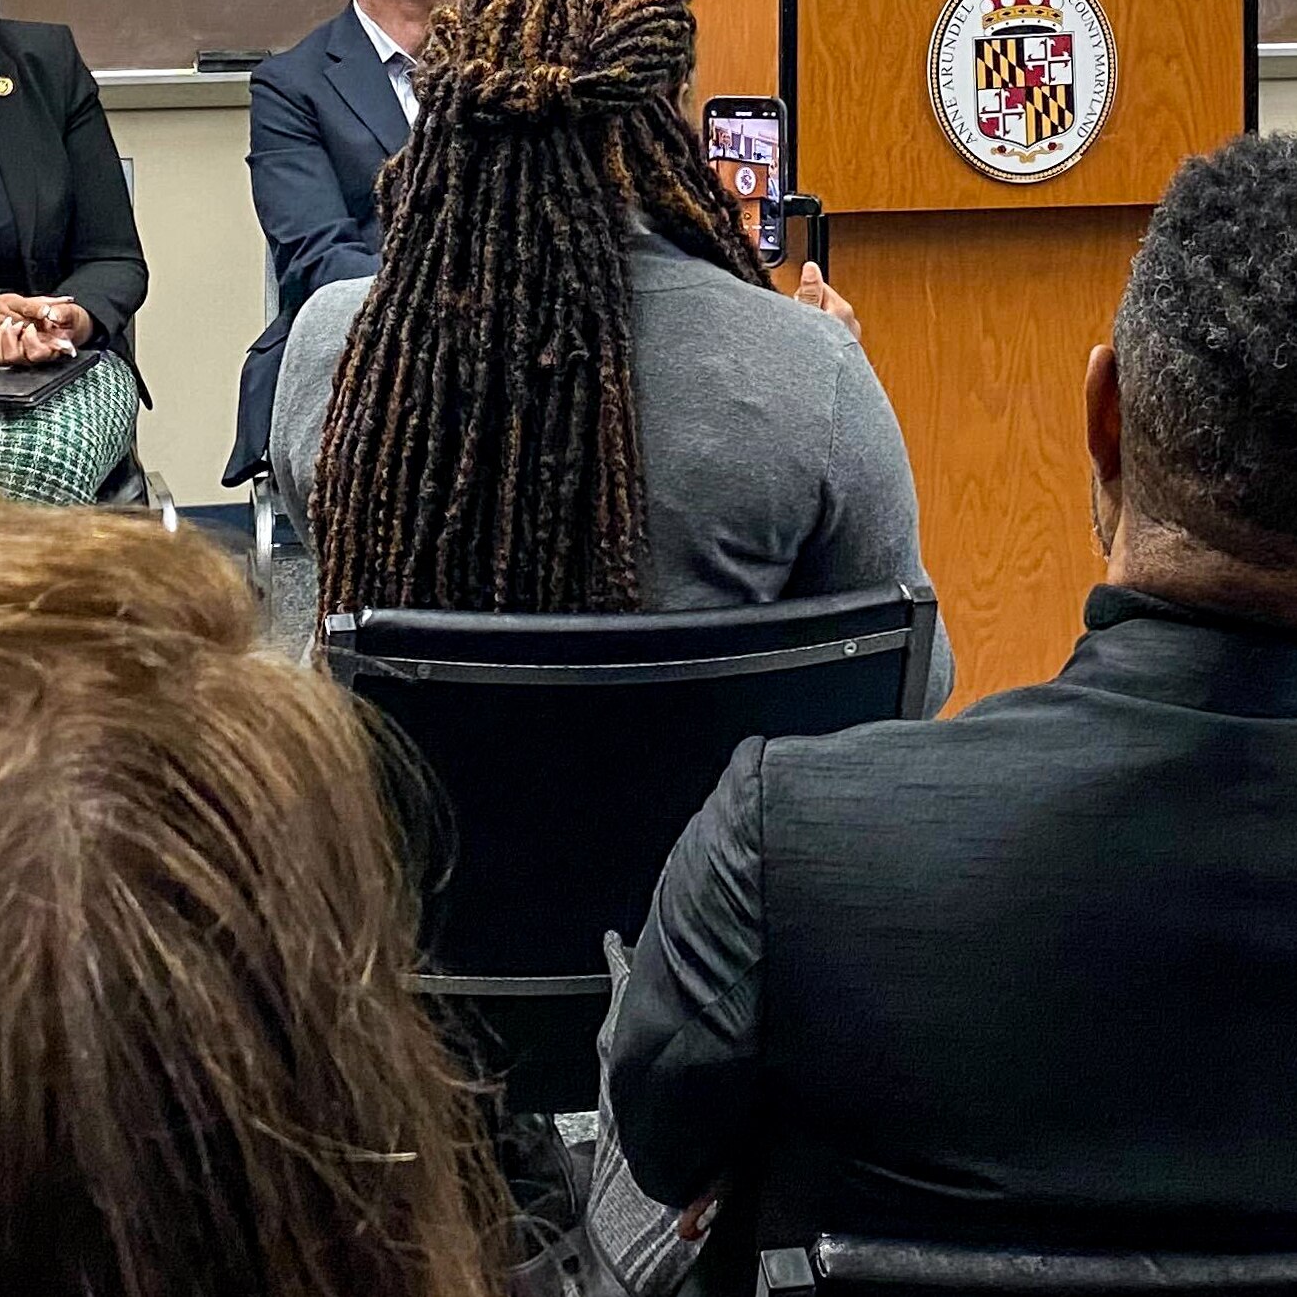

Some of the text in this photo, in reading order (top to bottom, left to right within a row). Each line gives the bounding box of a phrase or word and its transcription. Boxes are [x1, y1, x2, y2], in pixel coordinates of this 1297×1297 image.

[940, 3, 978, 145] ANNE ARUNDEL
[1077, 53, 1106, 139] MARYLAND
